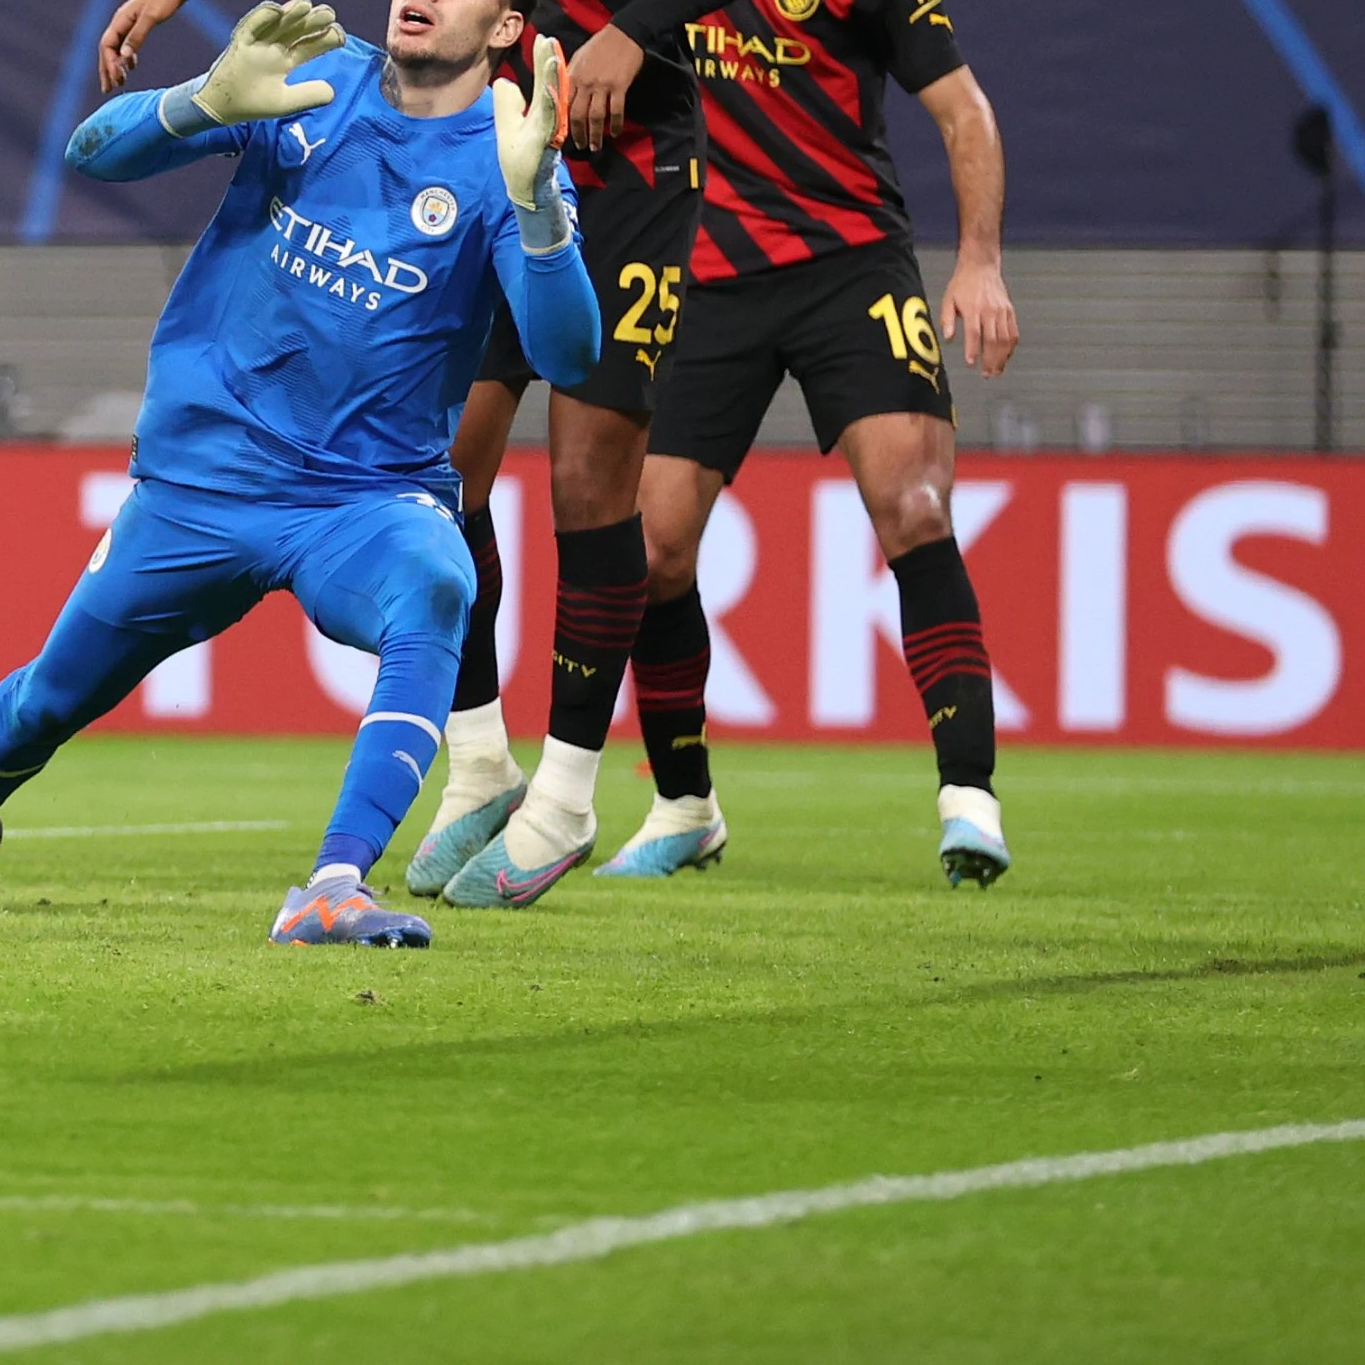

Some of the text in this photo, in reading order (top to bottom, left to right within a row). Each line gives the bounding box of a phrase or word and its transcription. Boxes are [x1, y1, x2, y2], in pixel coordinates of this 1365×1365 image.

[684, 22, 811, 65] TIHAD
[695, 57, 780, 88] IRWAYS
[270, 195, 429, 294] ETIHAD
[271, 243, 383, 311] AIRWAYS
[613, 261, 682, 345] 25
[868, 293, 941, 365] 16
